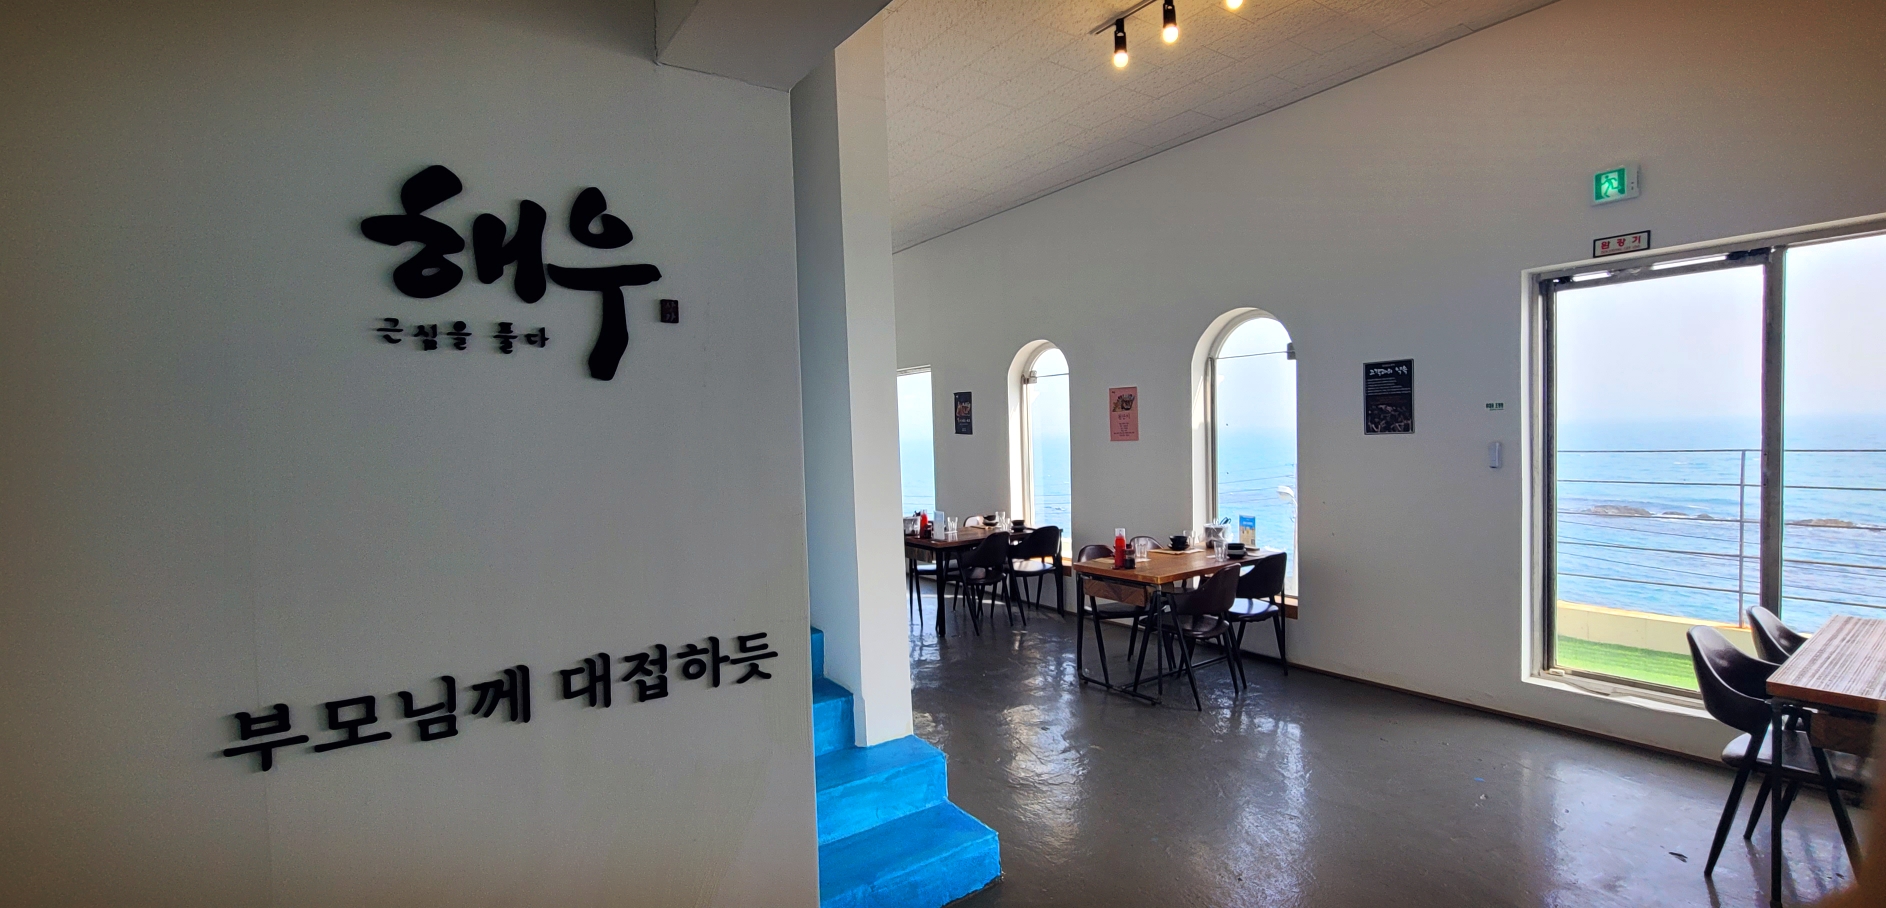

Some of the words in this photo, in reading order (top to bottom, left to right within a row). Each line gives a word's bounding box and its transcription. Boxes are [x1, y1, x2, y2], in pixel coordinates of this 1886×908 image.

[360, 165, 663, 381] 해우
[376, 317, 472, 352] 근심을
[492, 321, 551, 355] 풀다
[221, 664, 532, 772] 부모님께
[560, 632, 780, 708] 대접하듯
